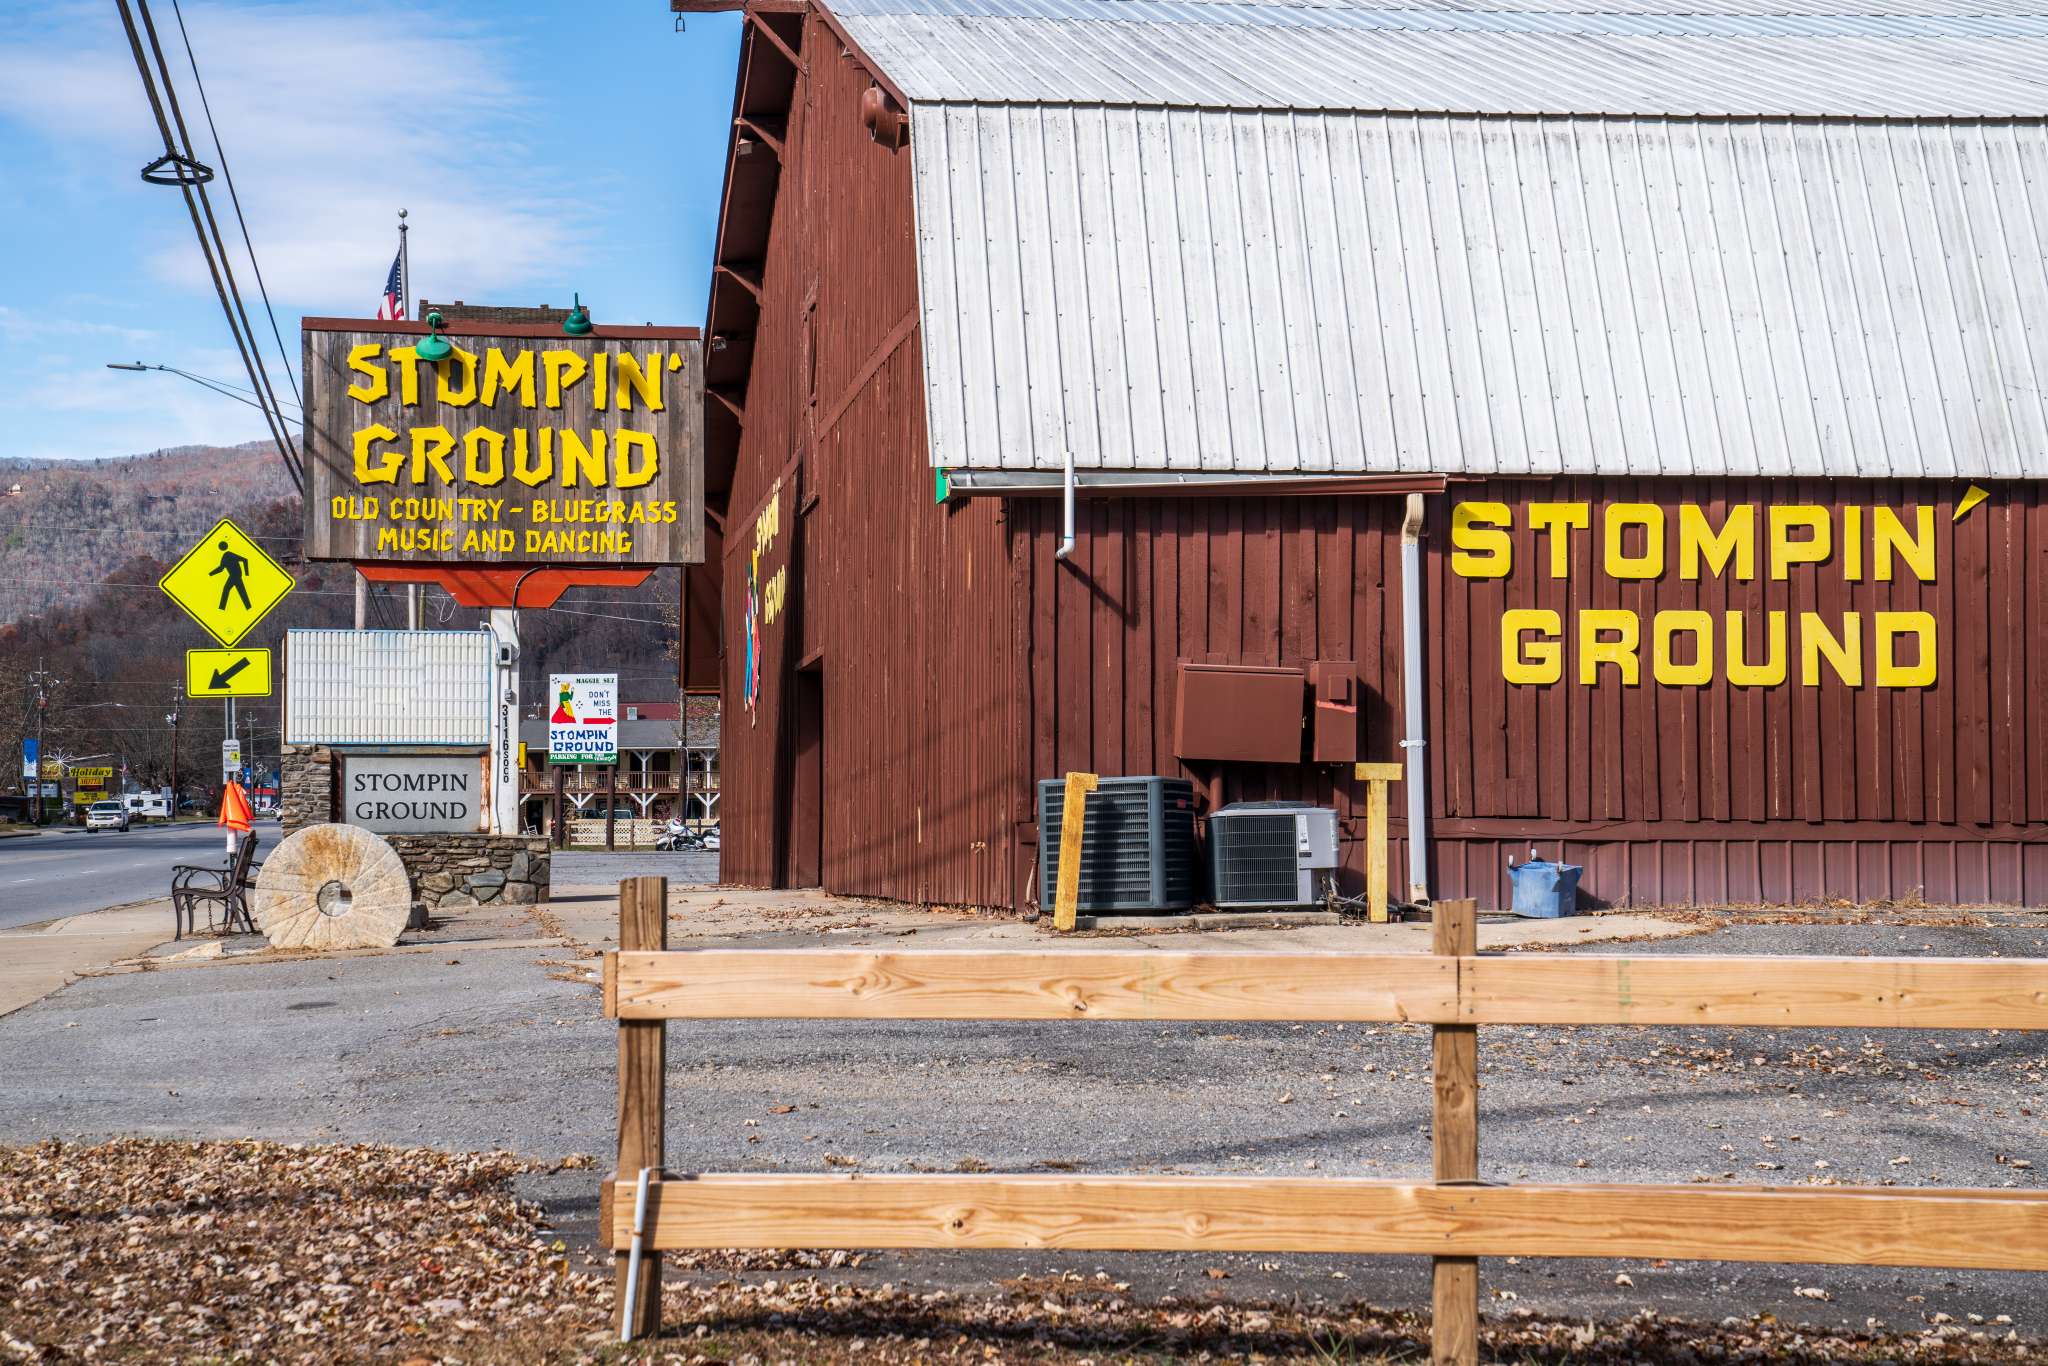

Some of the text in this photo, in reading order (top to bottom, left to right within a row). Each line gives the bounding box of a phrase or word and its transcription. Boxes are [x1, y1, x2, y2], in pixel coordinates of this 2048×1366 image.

[347, 343, 683, 412] STOMPIN'
[352, 423, 658, 489] GROUND
[331, 496, 380, 520] OLD
[388, 496, 504, 523] COUNTRY
[531, 498, 678, 526] BLUEGRASS
[377, 527, 633, 554] MUSIC AND DANCING
[1503, 609, 1937, 687] GROUND
[588, 690, 610, 698] DON'T
[598, 708, 612, 716] THE
[553, 741, 614, 752] GROUND
[70, 767, 112, 777] Holiday
[354, 773, 469, 792] STOMPIN
[355, 801, 468, 820] GROUND
